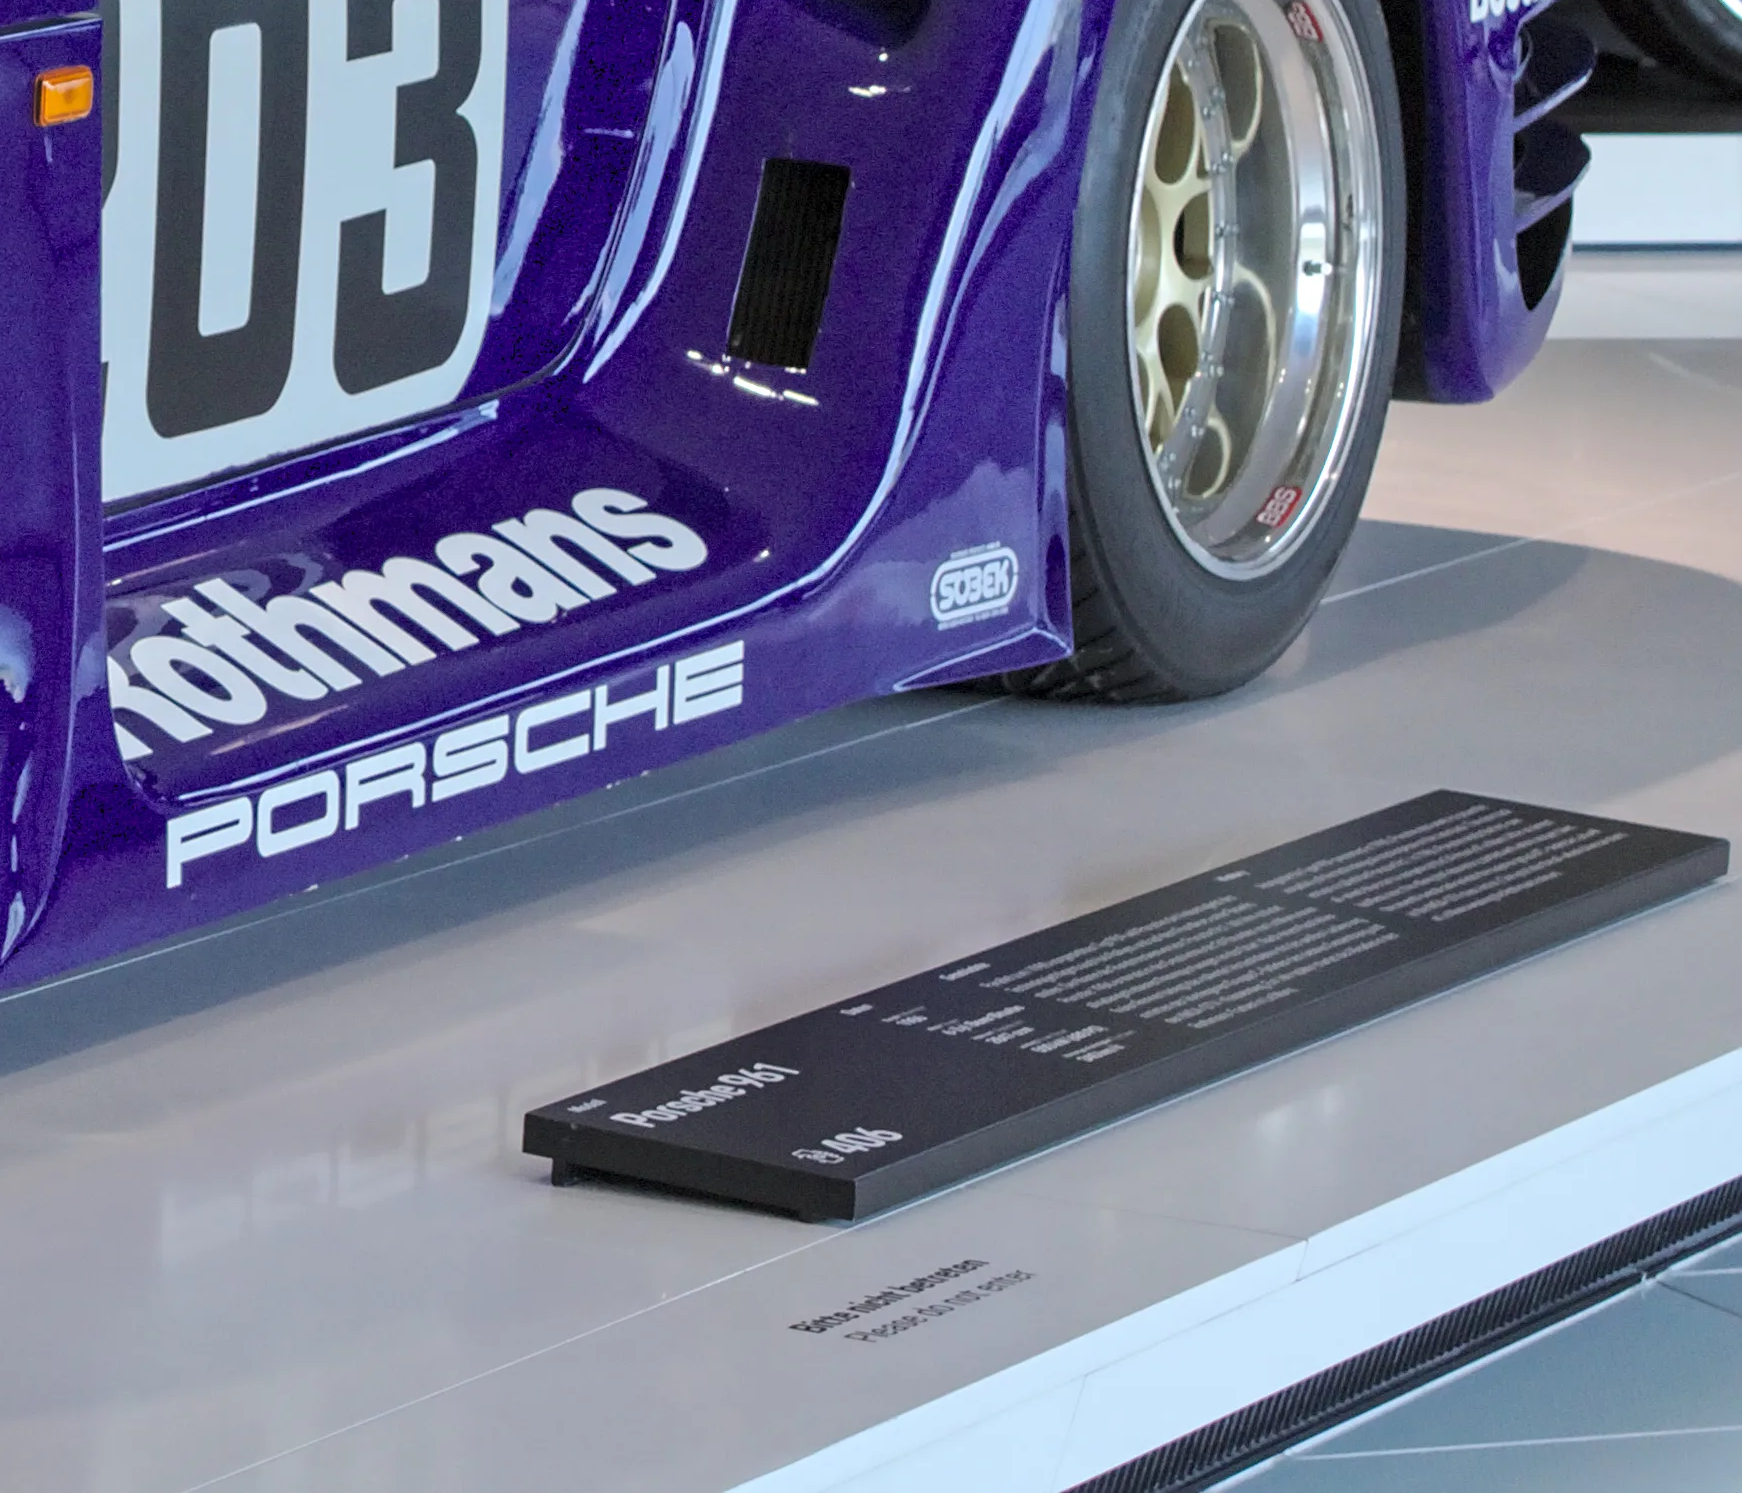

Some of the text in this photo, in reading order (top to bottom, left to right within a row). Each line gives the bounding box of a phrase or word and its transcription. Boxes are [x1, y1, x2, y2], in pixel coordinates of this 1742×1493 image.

[938, 558, 1010, 611] SOBEK
[164, 639, 745, 889] PORSCHE
[609, 1083, 747, 1129] Porsche
[717, 1062, 801, 1089] 961
[820, 1126, 904, 1157] 406
[788, 1259, 990, 1334] Bitte nicht betreten
[844, 1269, 1036, 1343] Please do not enter
